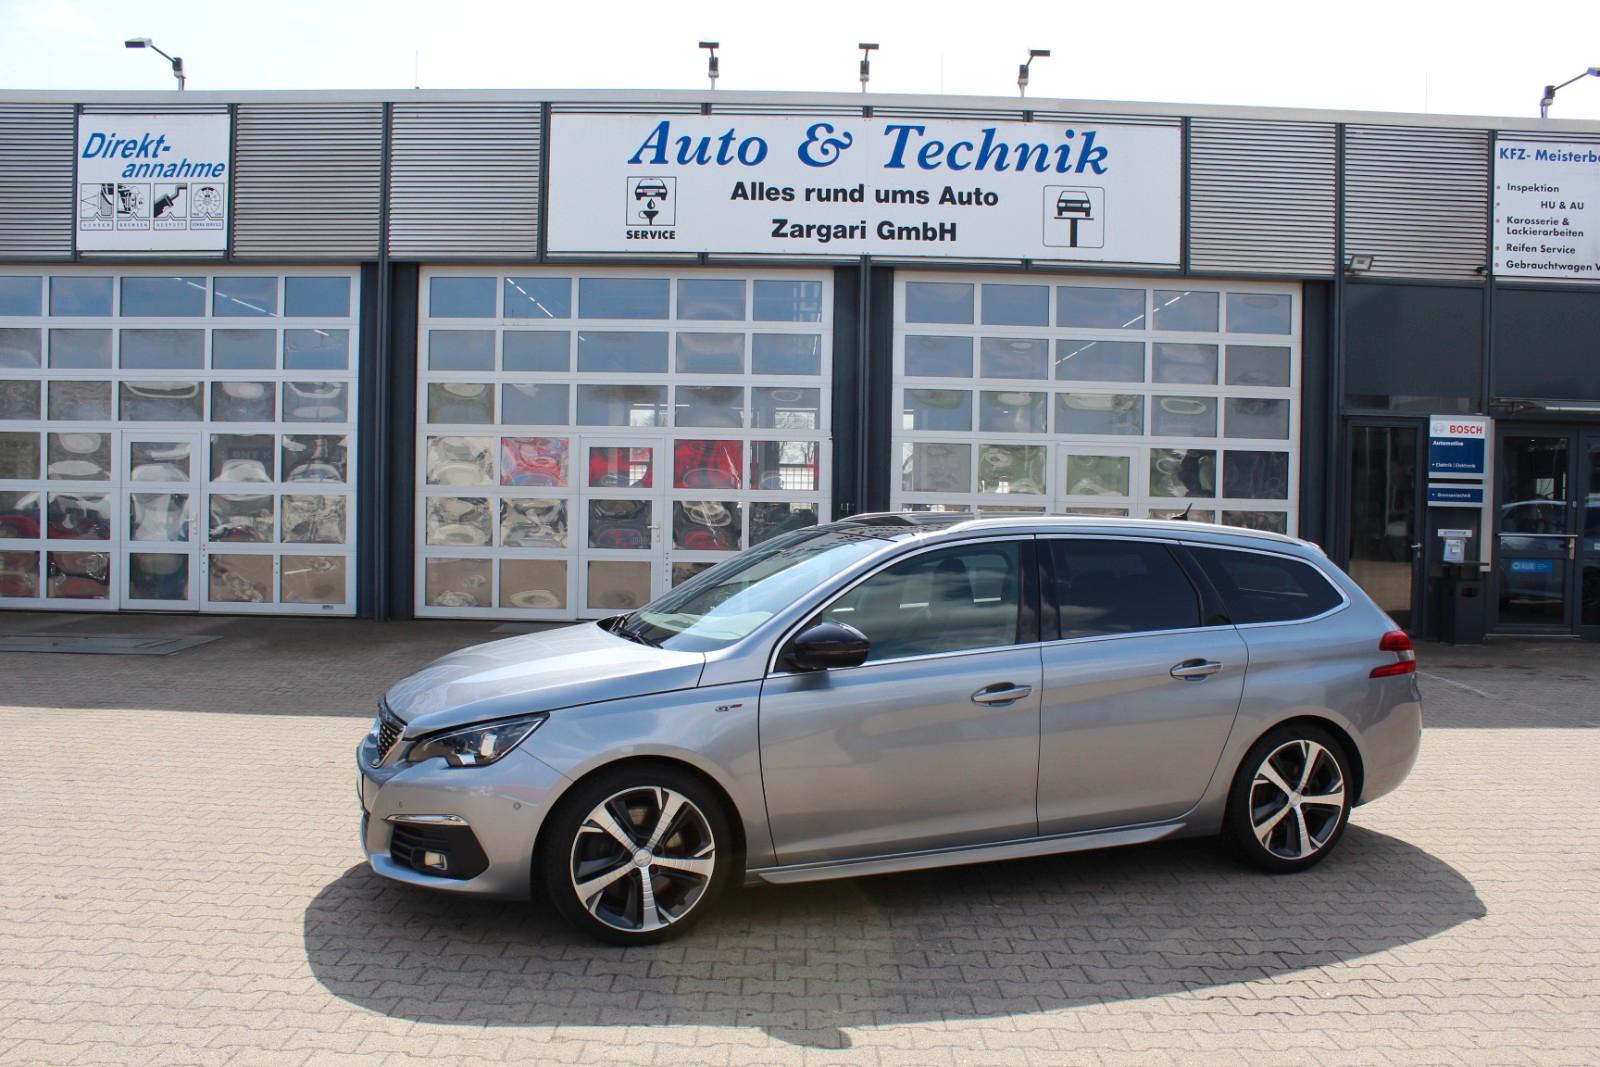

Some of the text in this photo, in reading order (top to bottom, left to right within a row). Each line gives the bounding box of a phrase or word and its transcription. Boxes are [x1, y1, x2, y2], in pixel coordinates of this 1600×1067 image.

[82, 132, 171, 158] Direkt-
[627, 119, 1109, 175] Auto & Technik
[1499, 148, 1530, 160] KFZ-
[122, 158, 225, 178] annahme
[731, 182, 999, 206] Alles rund ums Auto
[1507, 184, 1560, 194] Inspektion
[1541, 200, 1556, 209] HU
[1569, 202, 1584, 210] AU
[1506, 216, 1569, 225] Karosserie &
[627, 229, 676, 240] SERVICE
[772, 218, 957, 243] Zargari GmbH
[1506, 227, 1584, 238] Lackierarbeiten
[1506, 243, 1576, 255] Reifen Service
[1506, 260, 1593, 273] Gebrauchtwagen
[1449, 425, 1483, 434] BOSCH
